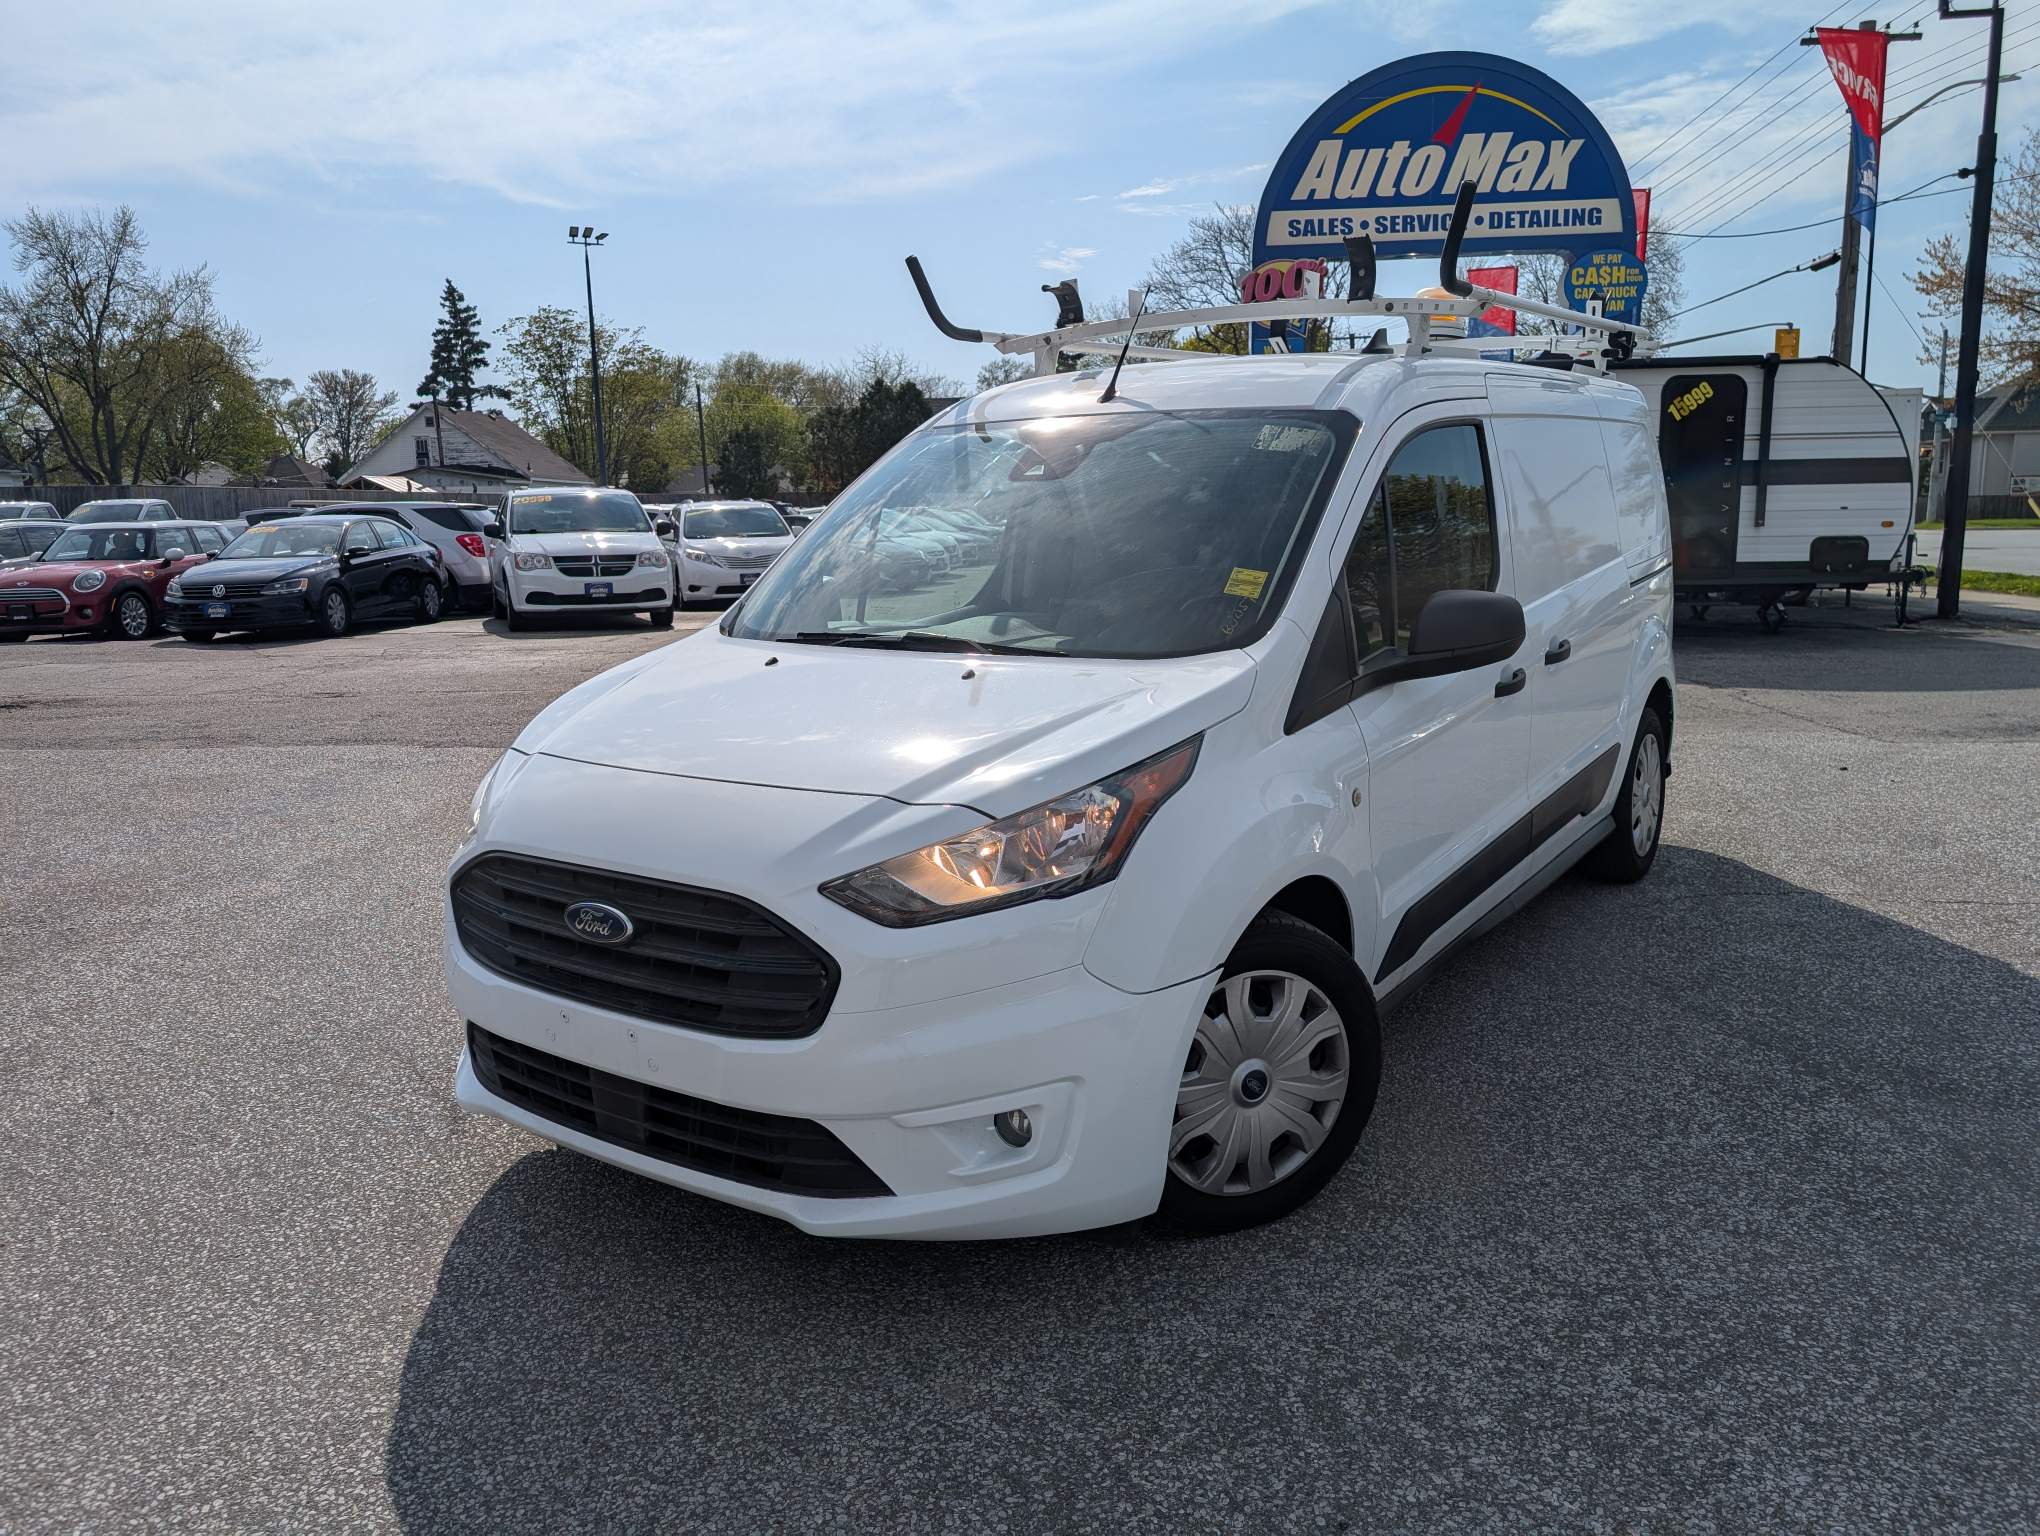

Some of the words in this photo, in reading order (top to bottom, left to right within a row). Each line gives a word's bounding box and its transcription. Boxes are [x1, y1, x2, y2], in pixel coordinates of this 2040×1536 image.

[1287, 216, 1354, 238] SALES
[1374, 211, 1463, 235] SERVIC
[1488, 207, 1603, 230] DETAILING
[1593, 254, 1606, 264] WE
[1607, 253, 1622, 264] PAY
[1571, 265, 1626, 287] CA$H
[1667, 381, 1714, 421] 15999
[575, 908, 613, 936] Ford
